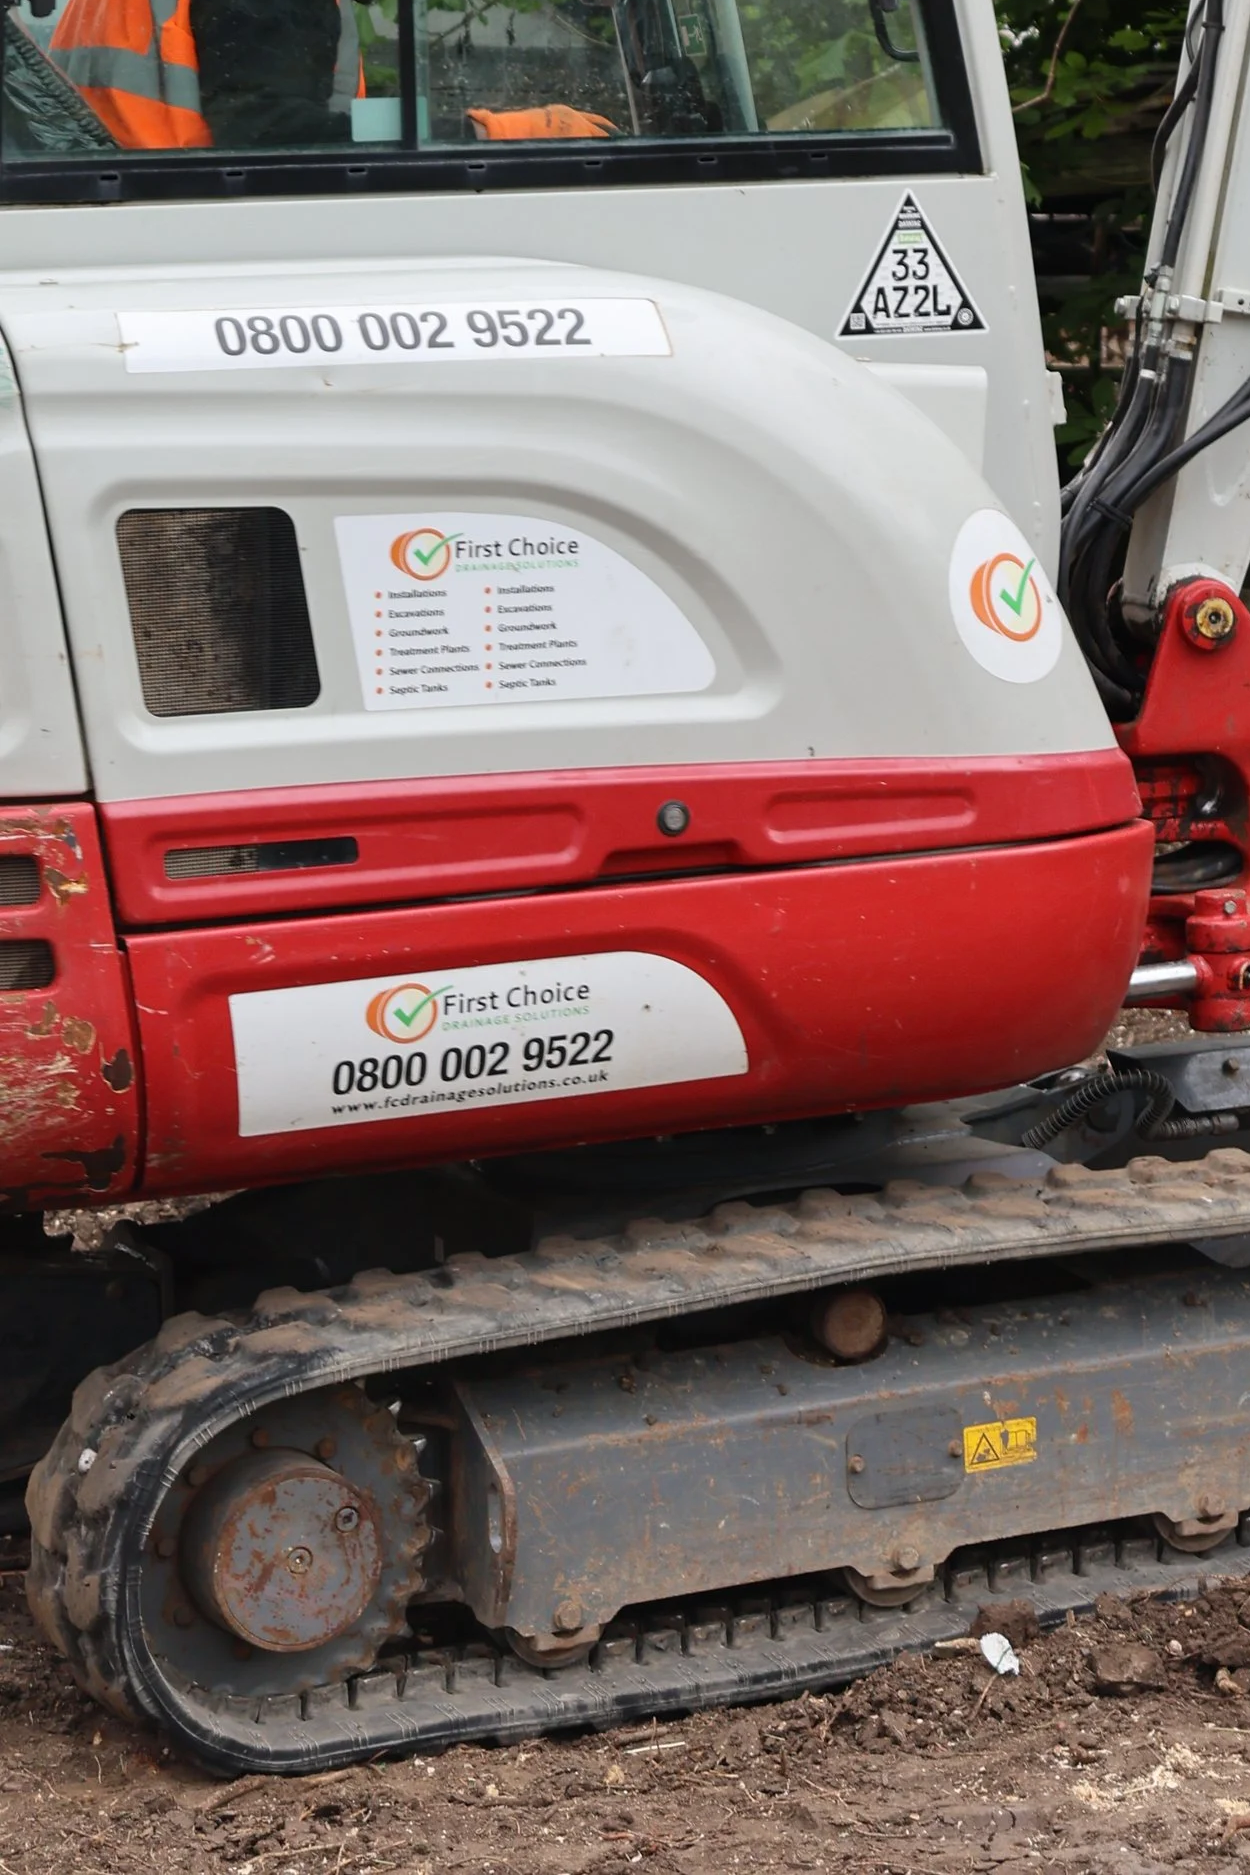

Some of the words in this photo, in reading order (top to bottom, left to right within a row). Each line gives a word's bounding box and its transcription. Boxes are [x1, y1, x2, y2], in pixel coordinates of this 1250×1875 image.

[892, 248, 930, 281] 33
[873, 285, 951, 319] AZ2L
[214, 313, 344, 356] 0800
[357, 310, 455, 350] 002
[466, 307, 592, 347] 9522
[455, 540, 502, 558] First
[509, 537, 579, 556] Choice
[455, 561, 511, 573] DRAINAGE
[513, 559, 580, 571] SOLUTIONS
[388, 589, 447, 600] Installations
[497, 584, 554, 595] Installations
[388, 608, 444, 619] Excavations
[497, 603, 552, 614] Excavations
[389, 627, 449, 638] Groundwork
[498, 622, 557, 633] Groundwork
[390, 646, 438, 657] Treatment
[441, 644, 470, 654] Plants
[498, 641, 546, 651] Treatment
[549, 639, 577, 649] Plants
[389, 666, 417, 676] Sewer
[420, 663, 479, 674] Connections
[498, 661, 526, 671] Sewer
[529, 658, 587, 669] Connections
[389, 684, 418, 696] Septic
[420, 683, 448, 693] Tanks
[499, 679, 528, 690] Septic
[530, 677, 556, 687] Tanks
[443, 990, 499, 1016] First
[507, 982, 590, 1008] Choice
[441, 1014, 509, 1031] DRAINAGE
[514, 1005, 590, 1023] SOLUTIONS
[332, 1051, 427, 1095] 0800
[441, 1041, 510, 1082] 002
[523, 1029, 614, 1072] 9522
[332, 1070, 609, 1115] www.fcdrainagesolutions.co.uk
